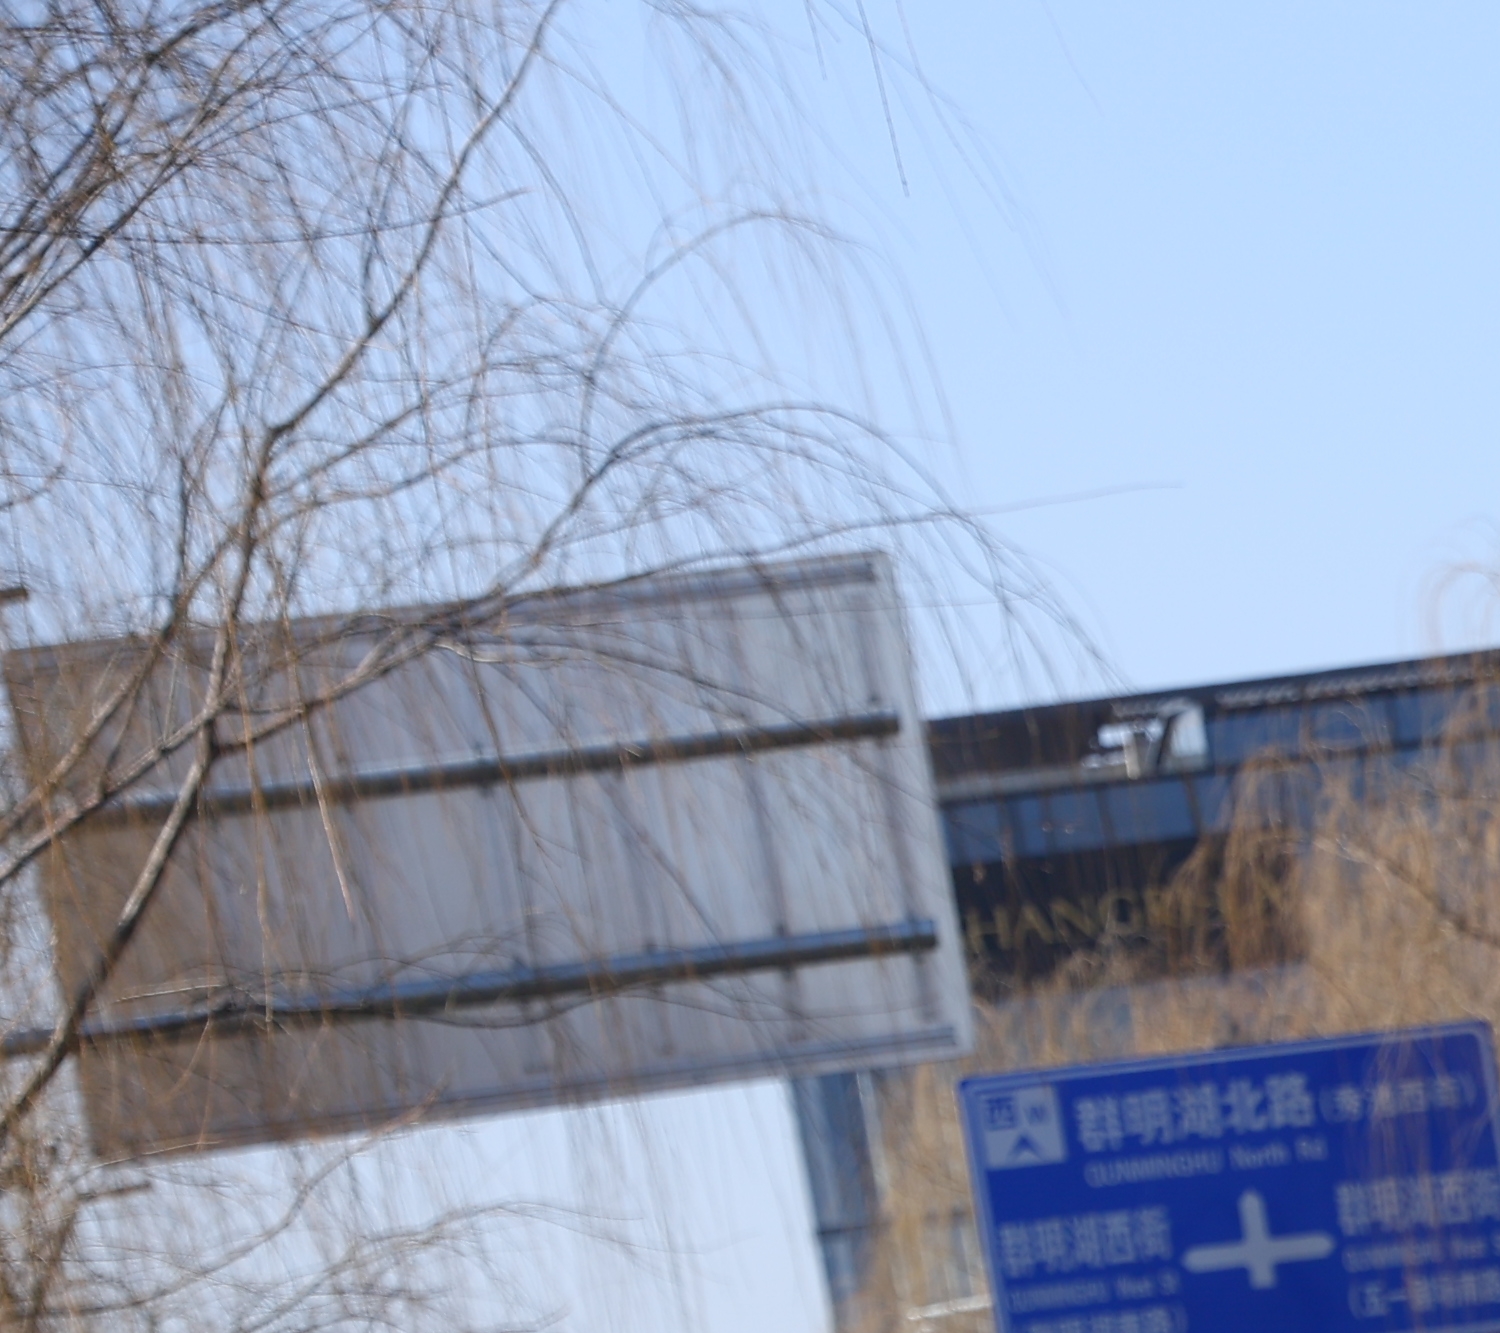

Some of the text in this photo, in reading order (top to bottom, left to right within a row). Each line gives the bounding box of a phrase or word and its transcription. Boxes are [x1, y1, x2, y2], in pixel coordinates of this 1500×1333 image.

[985, 1098, 1018, 1130] 西
[1077, 1073, 1313, 1151] 群明湖北路
